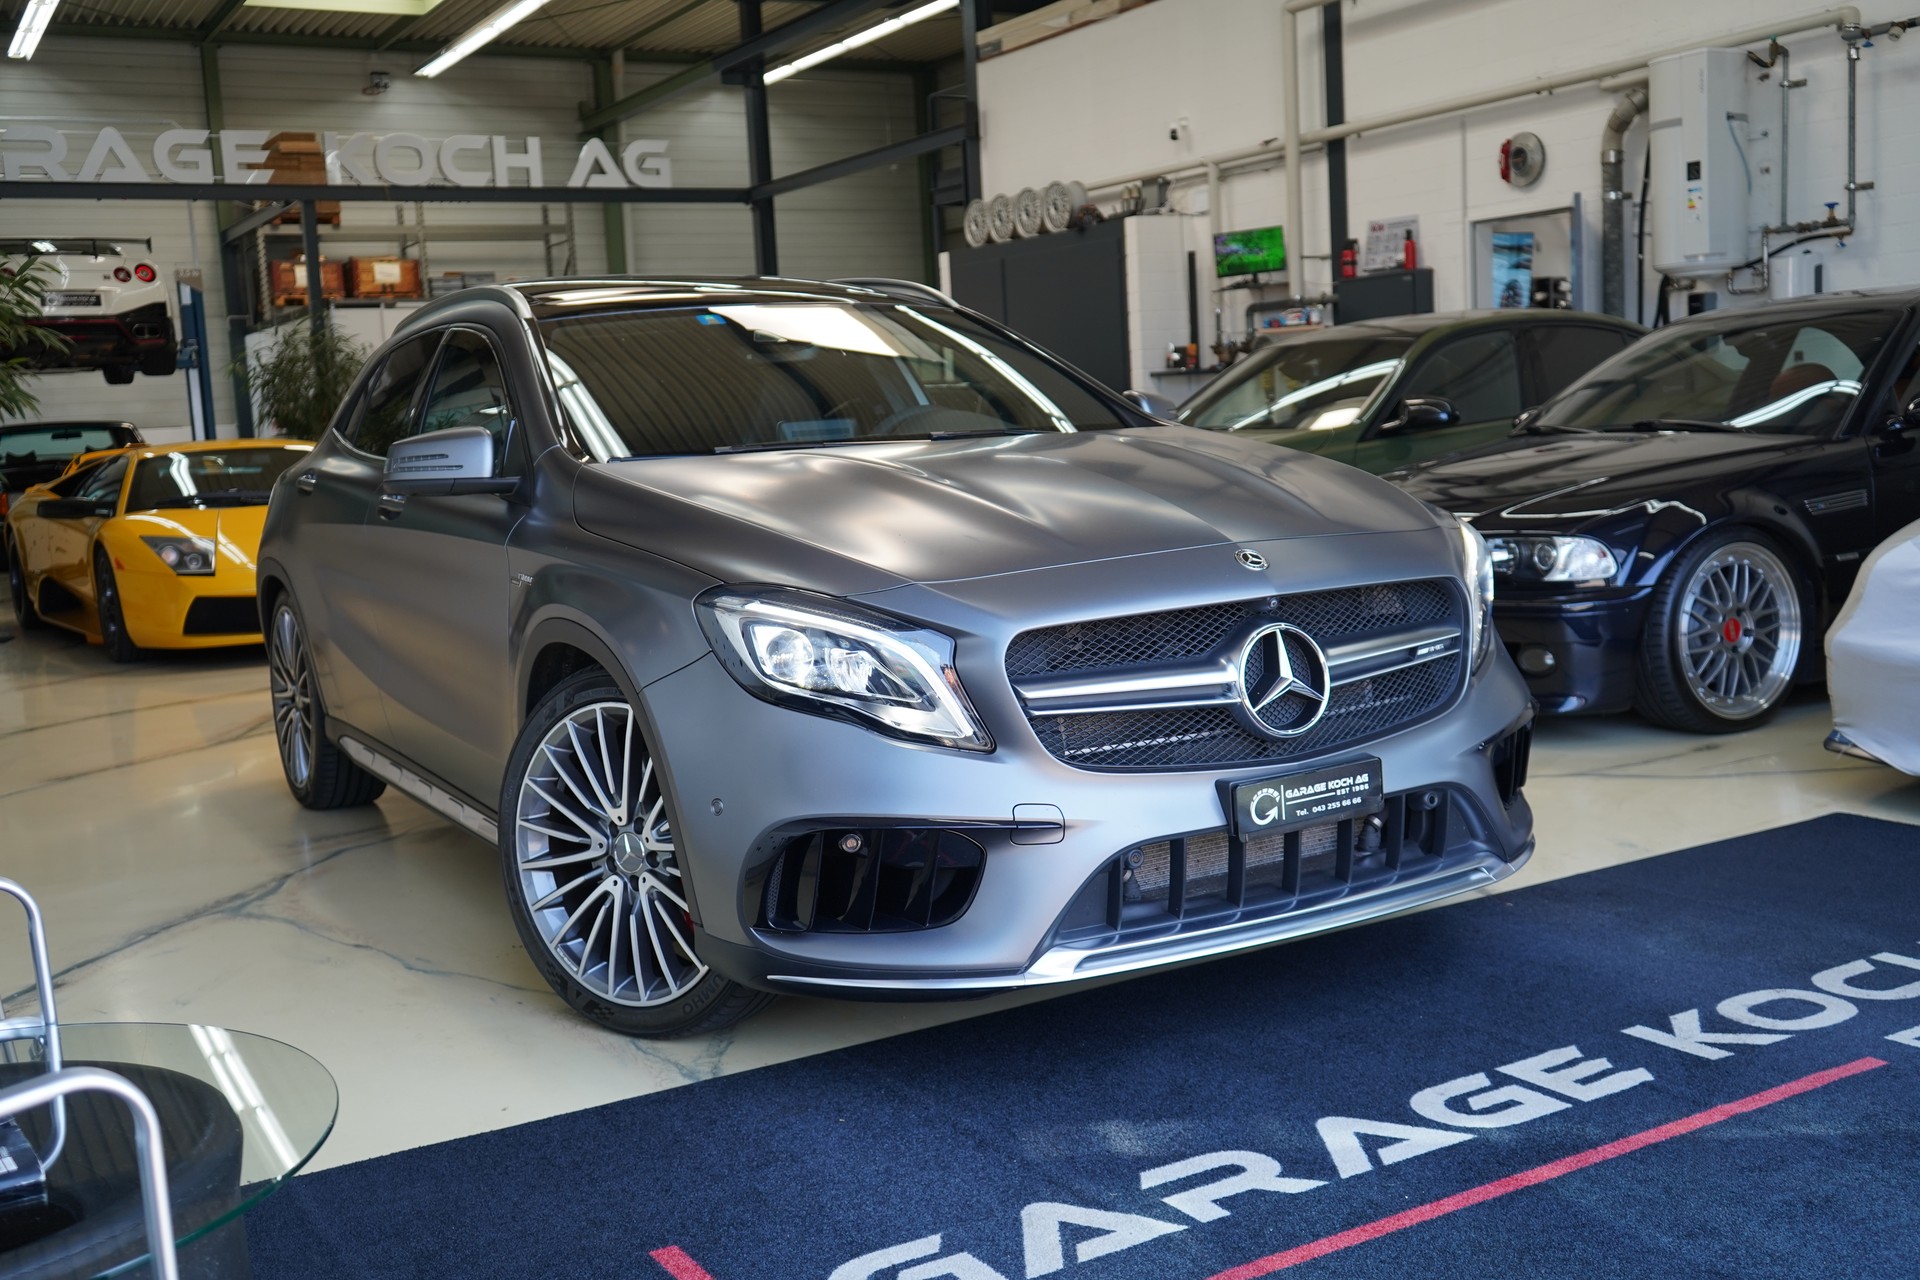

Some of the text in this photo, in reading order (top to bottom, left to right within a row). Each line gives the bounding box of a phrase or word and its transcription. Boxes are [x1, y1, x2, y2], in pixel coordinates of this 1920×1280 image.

[324, 131, 543, 187] KOCH
[567, 137, 673, 188] AG
[1285, 773, 1369, 798] GARAGE KOCH AG
[1336, 787, 1350, 796] EST
[1296, 808, 1309, 817] Tel.
[1312, 804, 1326, 813] 043
[1327, 801, 1341, 810] 255
[682, 973, 725, 1015] UMHO
